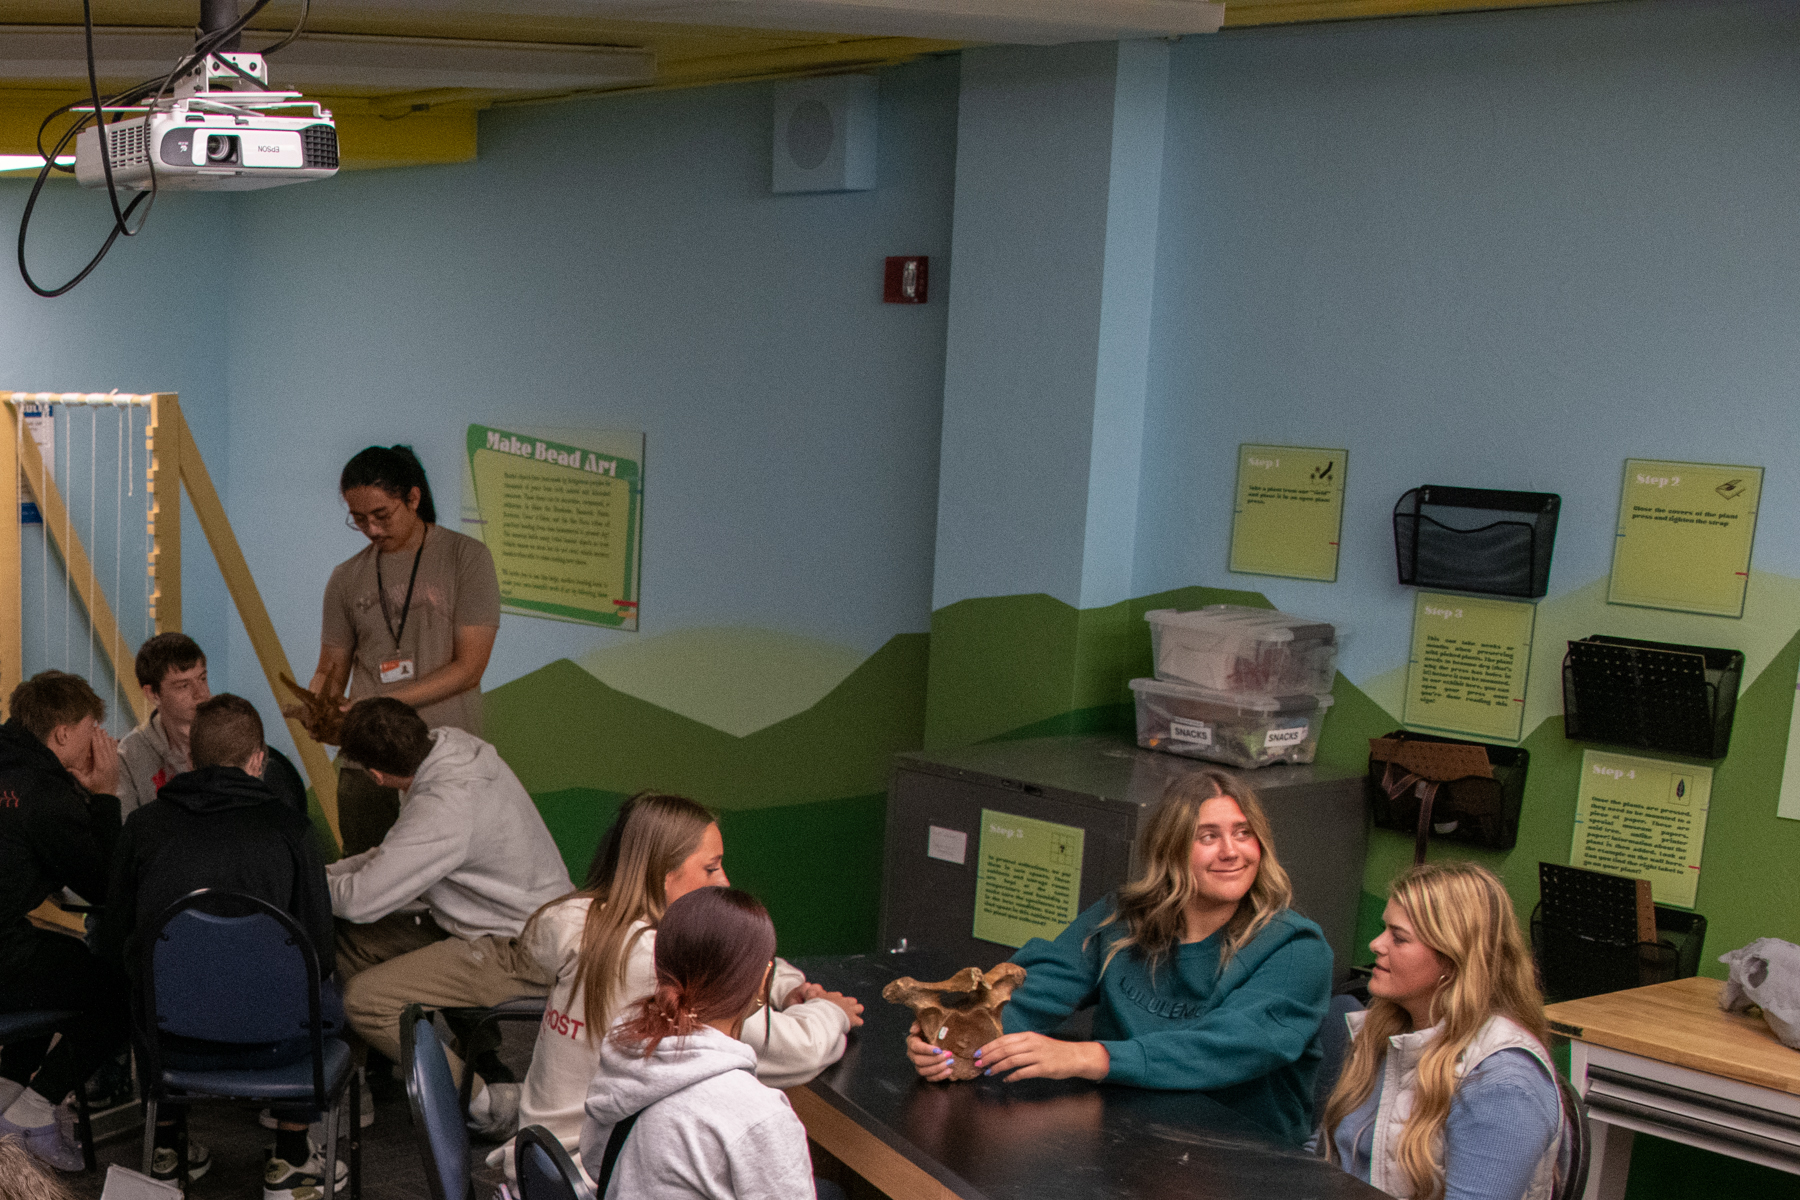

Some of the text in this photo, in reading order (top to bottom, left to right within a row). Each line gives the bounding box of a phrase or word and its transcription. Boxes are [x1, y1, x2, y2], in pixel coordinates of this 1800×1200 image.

[258, 145, 280, 153] EPSON
[486, 430, 617, 477] Make Bead Art
[1248, 457, 1274, 470] Step
[1636, 474, 1680, 488] Step 2
[1425, 606, 1463, 619] Step 3
[1174, 727, 1207, 740] SNACKS
[1268, 732, 1299, 742] SNACKS
[1593, 764, 1635, 780] Step 4
[989, 823, 1015, 839] Step
